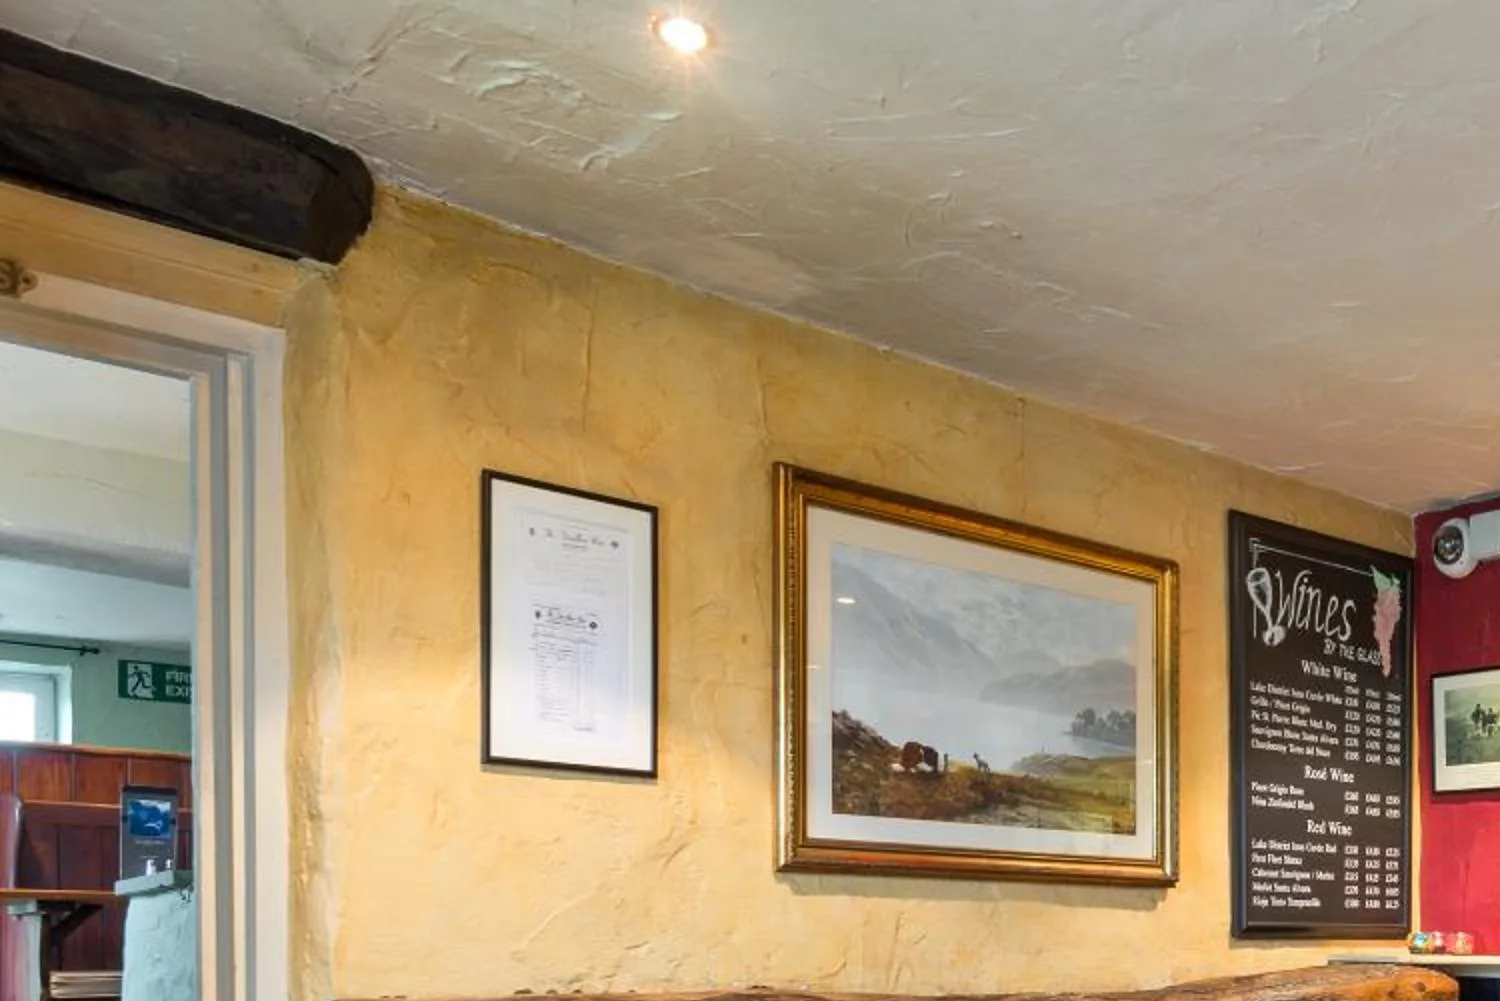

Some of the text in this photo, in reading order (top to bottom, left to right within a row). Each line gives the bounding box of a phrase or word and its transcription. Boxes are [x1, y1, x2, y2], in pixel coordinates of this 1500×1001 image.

[1275, 569, 1357, 641] Wines
[165, 671, 189, 684] FIR
[1301, 659, 1358, 683] White Wine
[165, 685, 190, 697] EXI
[1329, 767, 1355, 783] Wine
[1307, 819, 1353, 837] Red Wine
